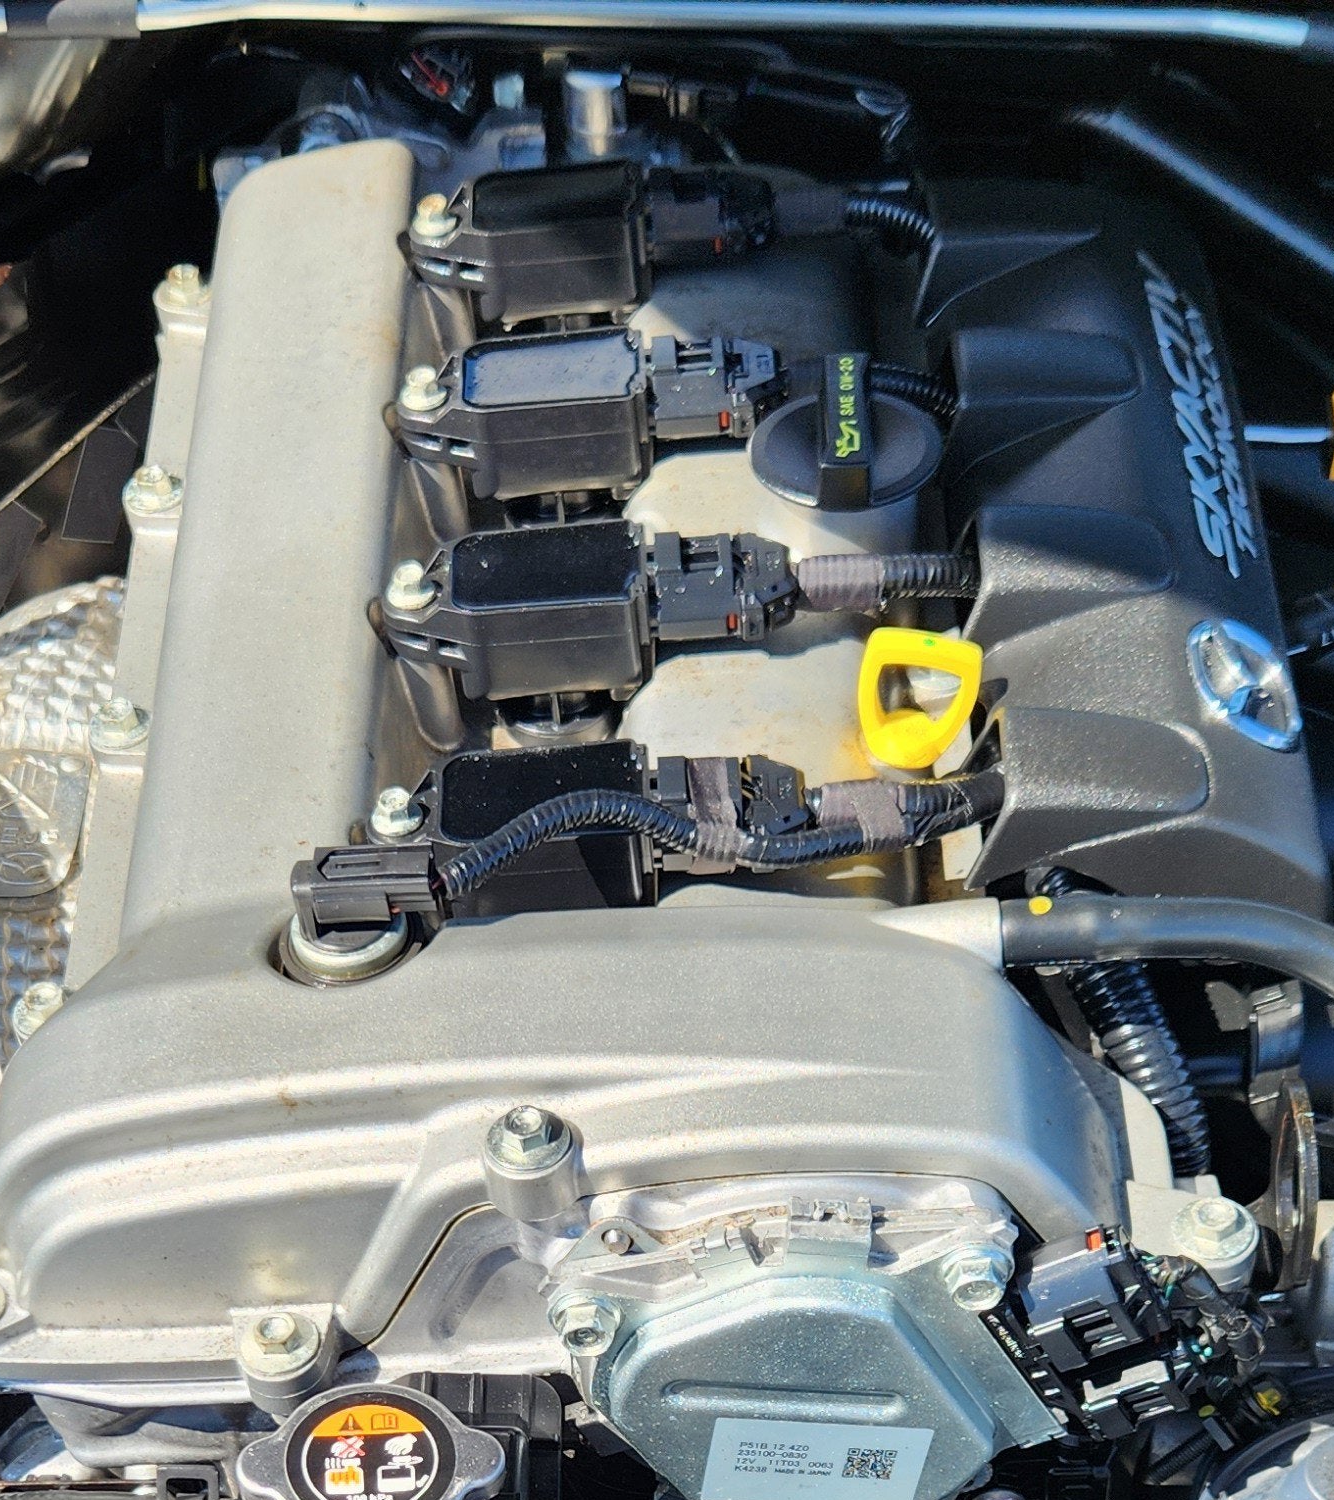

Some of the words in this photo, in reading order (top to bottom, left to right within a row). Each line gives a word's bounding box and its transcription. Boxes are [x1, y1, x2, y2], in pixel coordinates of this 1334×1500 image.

[838, 357, 854, 390] 0W-20
[839, 396, 855, 416] SAE
[1137, 250, 1240, 579] SKYACTIV
[739, 1441, 768, 1450] P51B
[773, 1443, 786, 1451] 12
[788, 1444, 810, 1452] 4Z0
[737, 1449, 808, 1460] 235100-0830
[734, 1465, 768, 1473] K4238
[807, 1461, 834, 1470] 0063
